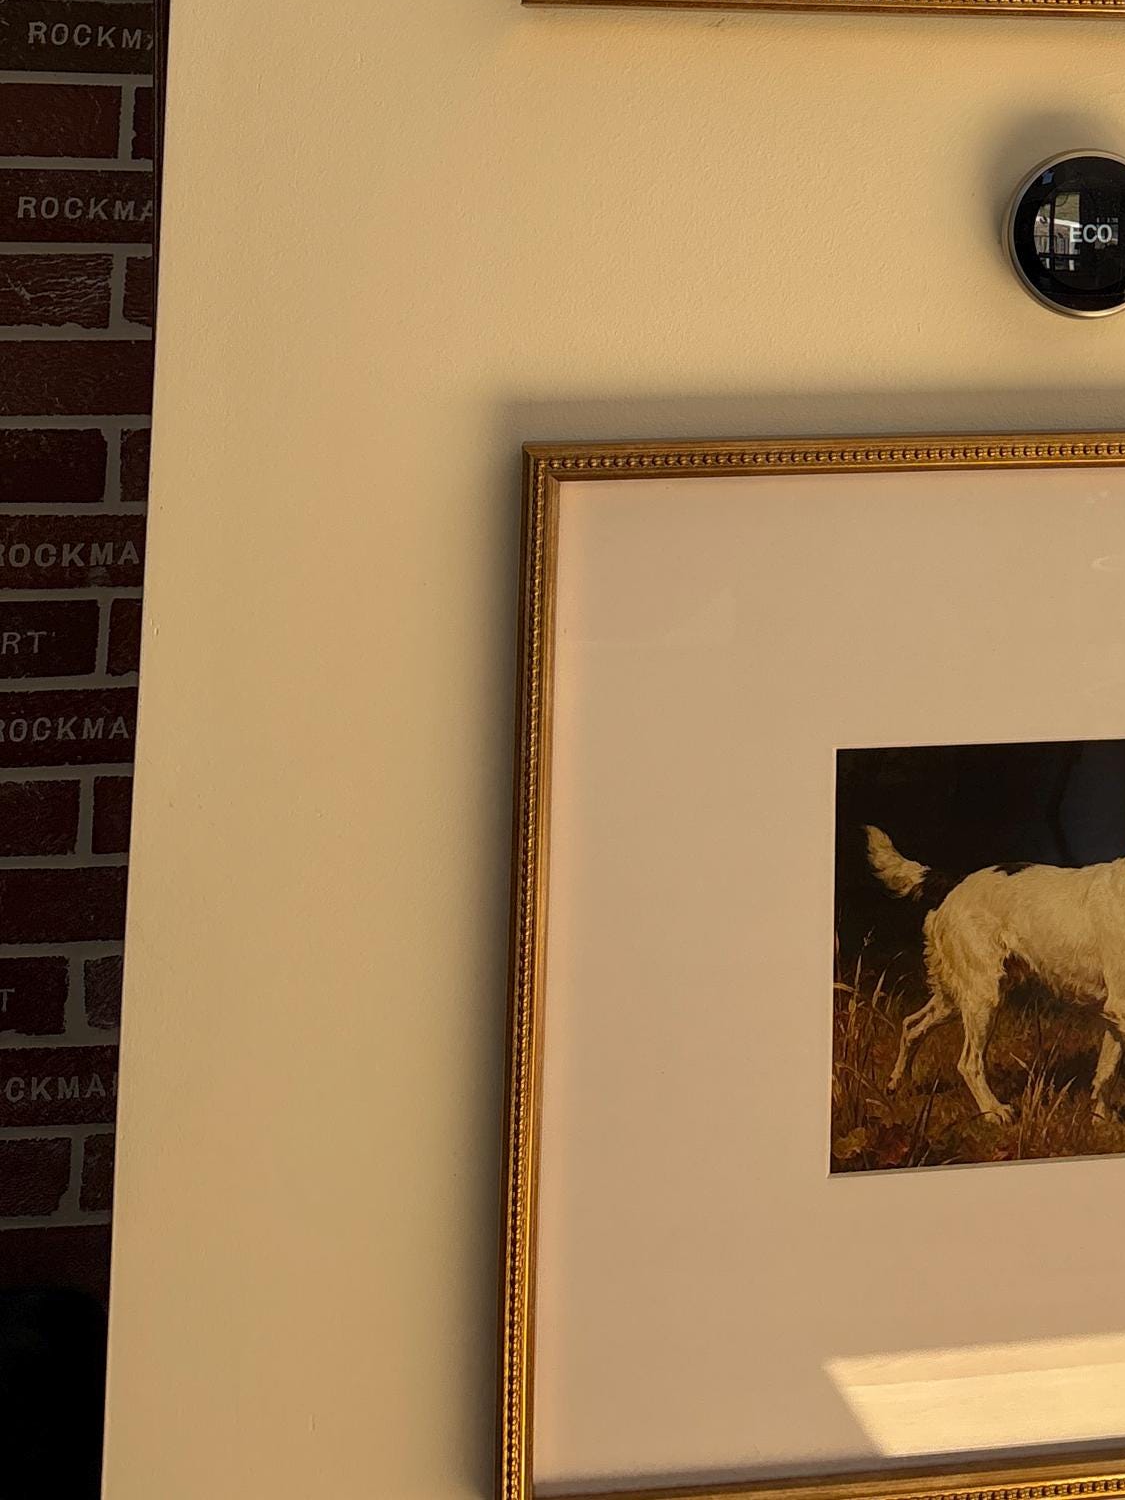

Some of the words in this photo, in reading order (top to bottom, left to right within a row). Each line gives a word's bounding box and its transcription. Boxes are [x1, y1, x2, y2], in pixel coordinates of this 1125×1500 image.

[1071, 224, 1112, 244] ECO
[0, 540, 140, 568] OCKMA
[0, 716, 130, 743] OCKMA
[3, 1072, 118, 1104] CKMA
